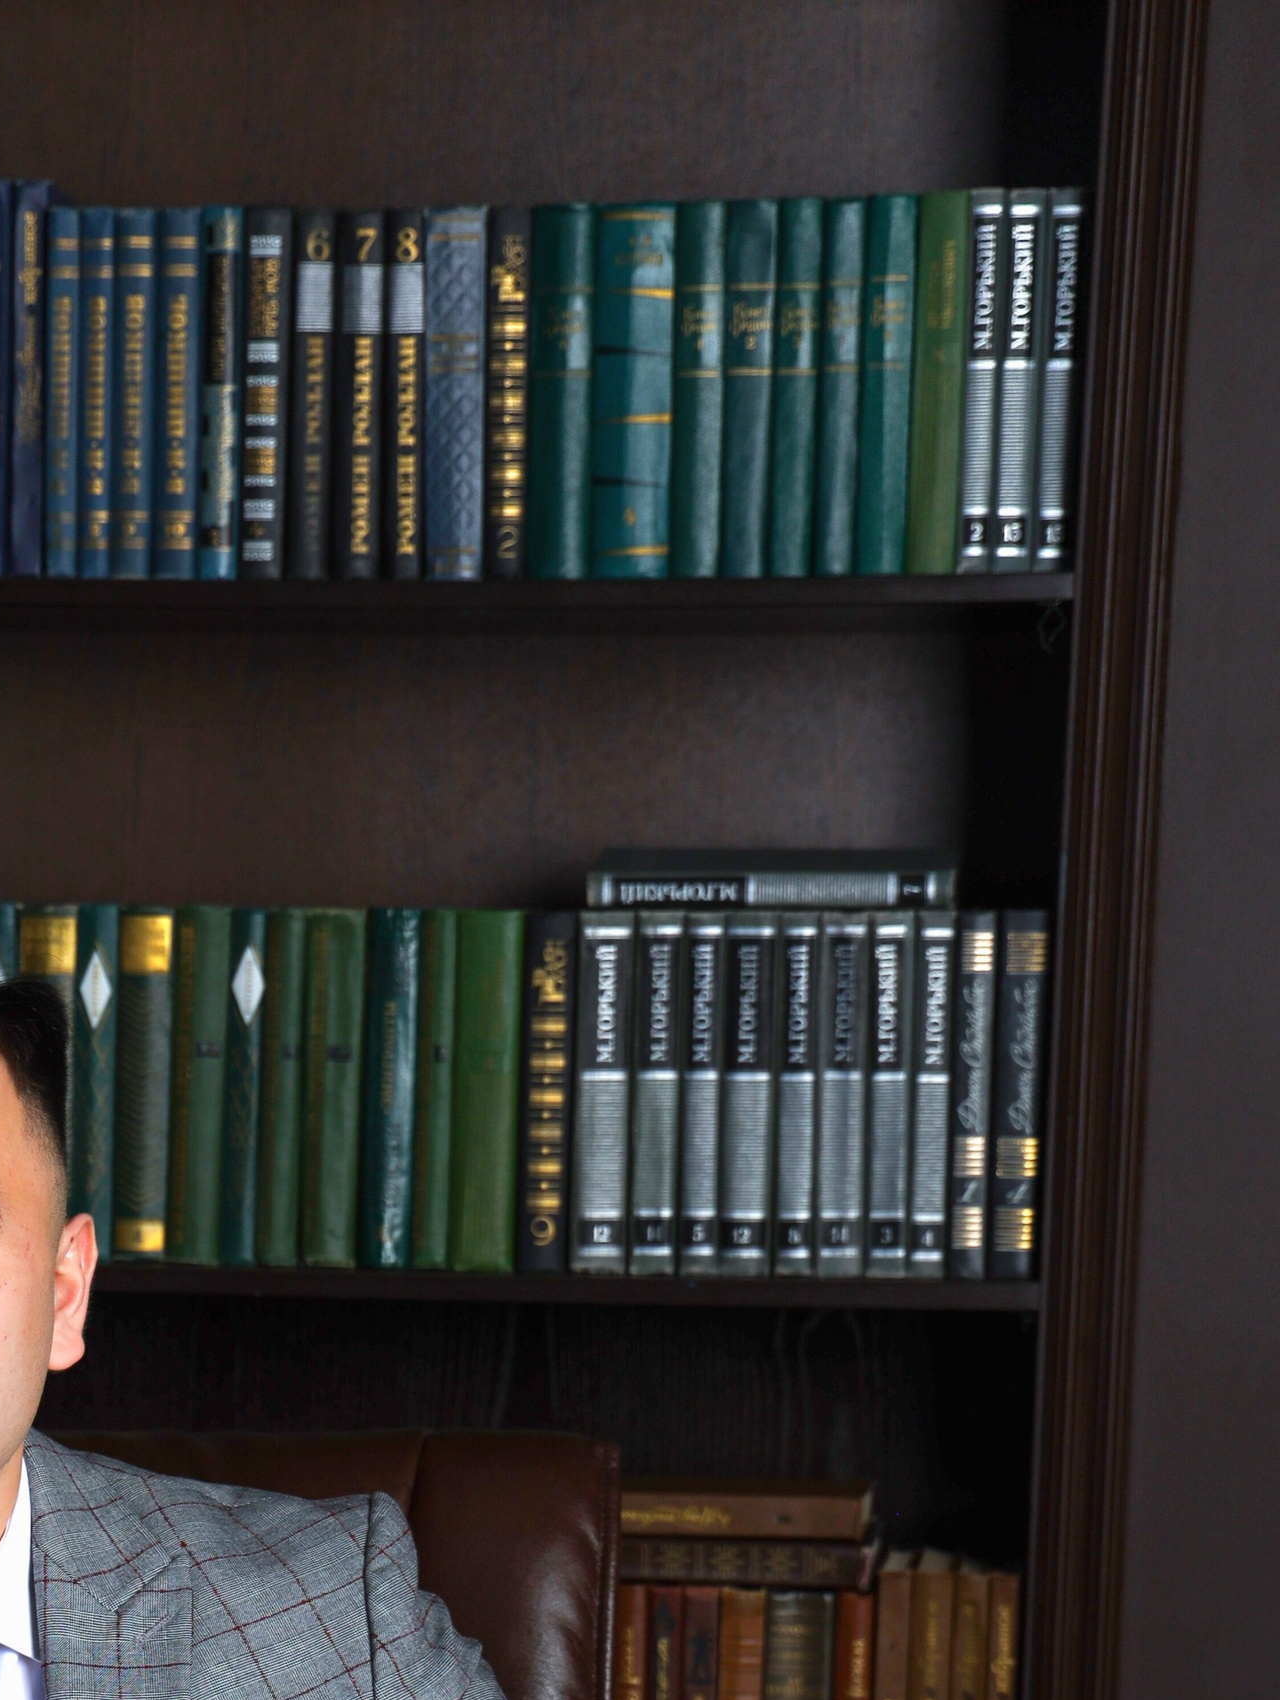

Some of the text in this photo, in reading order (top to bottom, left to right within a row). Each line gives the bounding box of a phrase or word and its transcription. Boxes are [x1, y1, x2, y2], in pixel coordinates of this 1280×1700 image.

[306, 226, 331, 261] 6
[356, 227, 377, 261] 7
[397, 227, 419, 262] 8
[350, 337, 374, 555] РОМЕН РОЛЛАН
[396, 336, 418, 555] РОМЕН РОЛЛАН
[497, 526, 516, 559] 2
[970, 522, 984, 541] 2
[621, 881, 738, 904] М.ГОРЬКИЙ
[596, 944, 617, 1063] М.ГОРЬКИЙ
[649, 944, 671, 1062] М.ГОРЬКИЙ
[692, 944, 714, 1062] М.ГОРЬКИЙ
[738, 945, 759, 1063] М.ГОРЬКИЙ
[788, 945, 809, 1064] М.ГОРЬКИЙ
[875, 944, 898, 1062] М.ГОРЬКИЙ
[925, 946, 947, 1065] М.ГОРЬКИЙ
